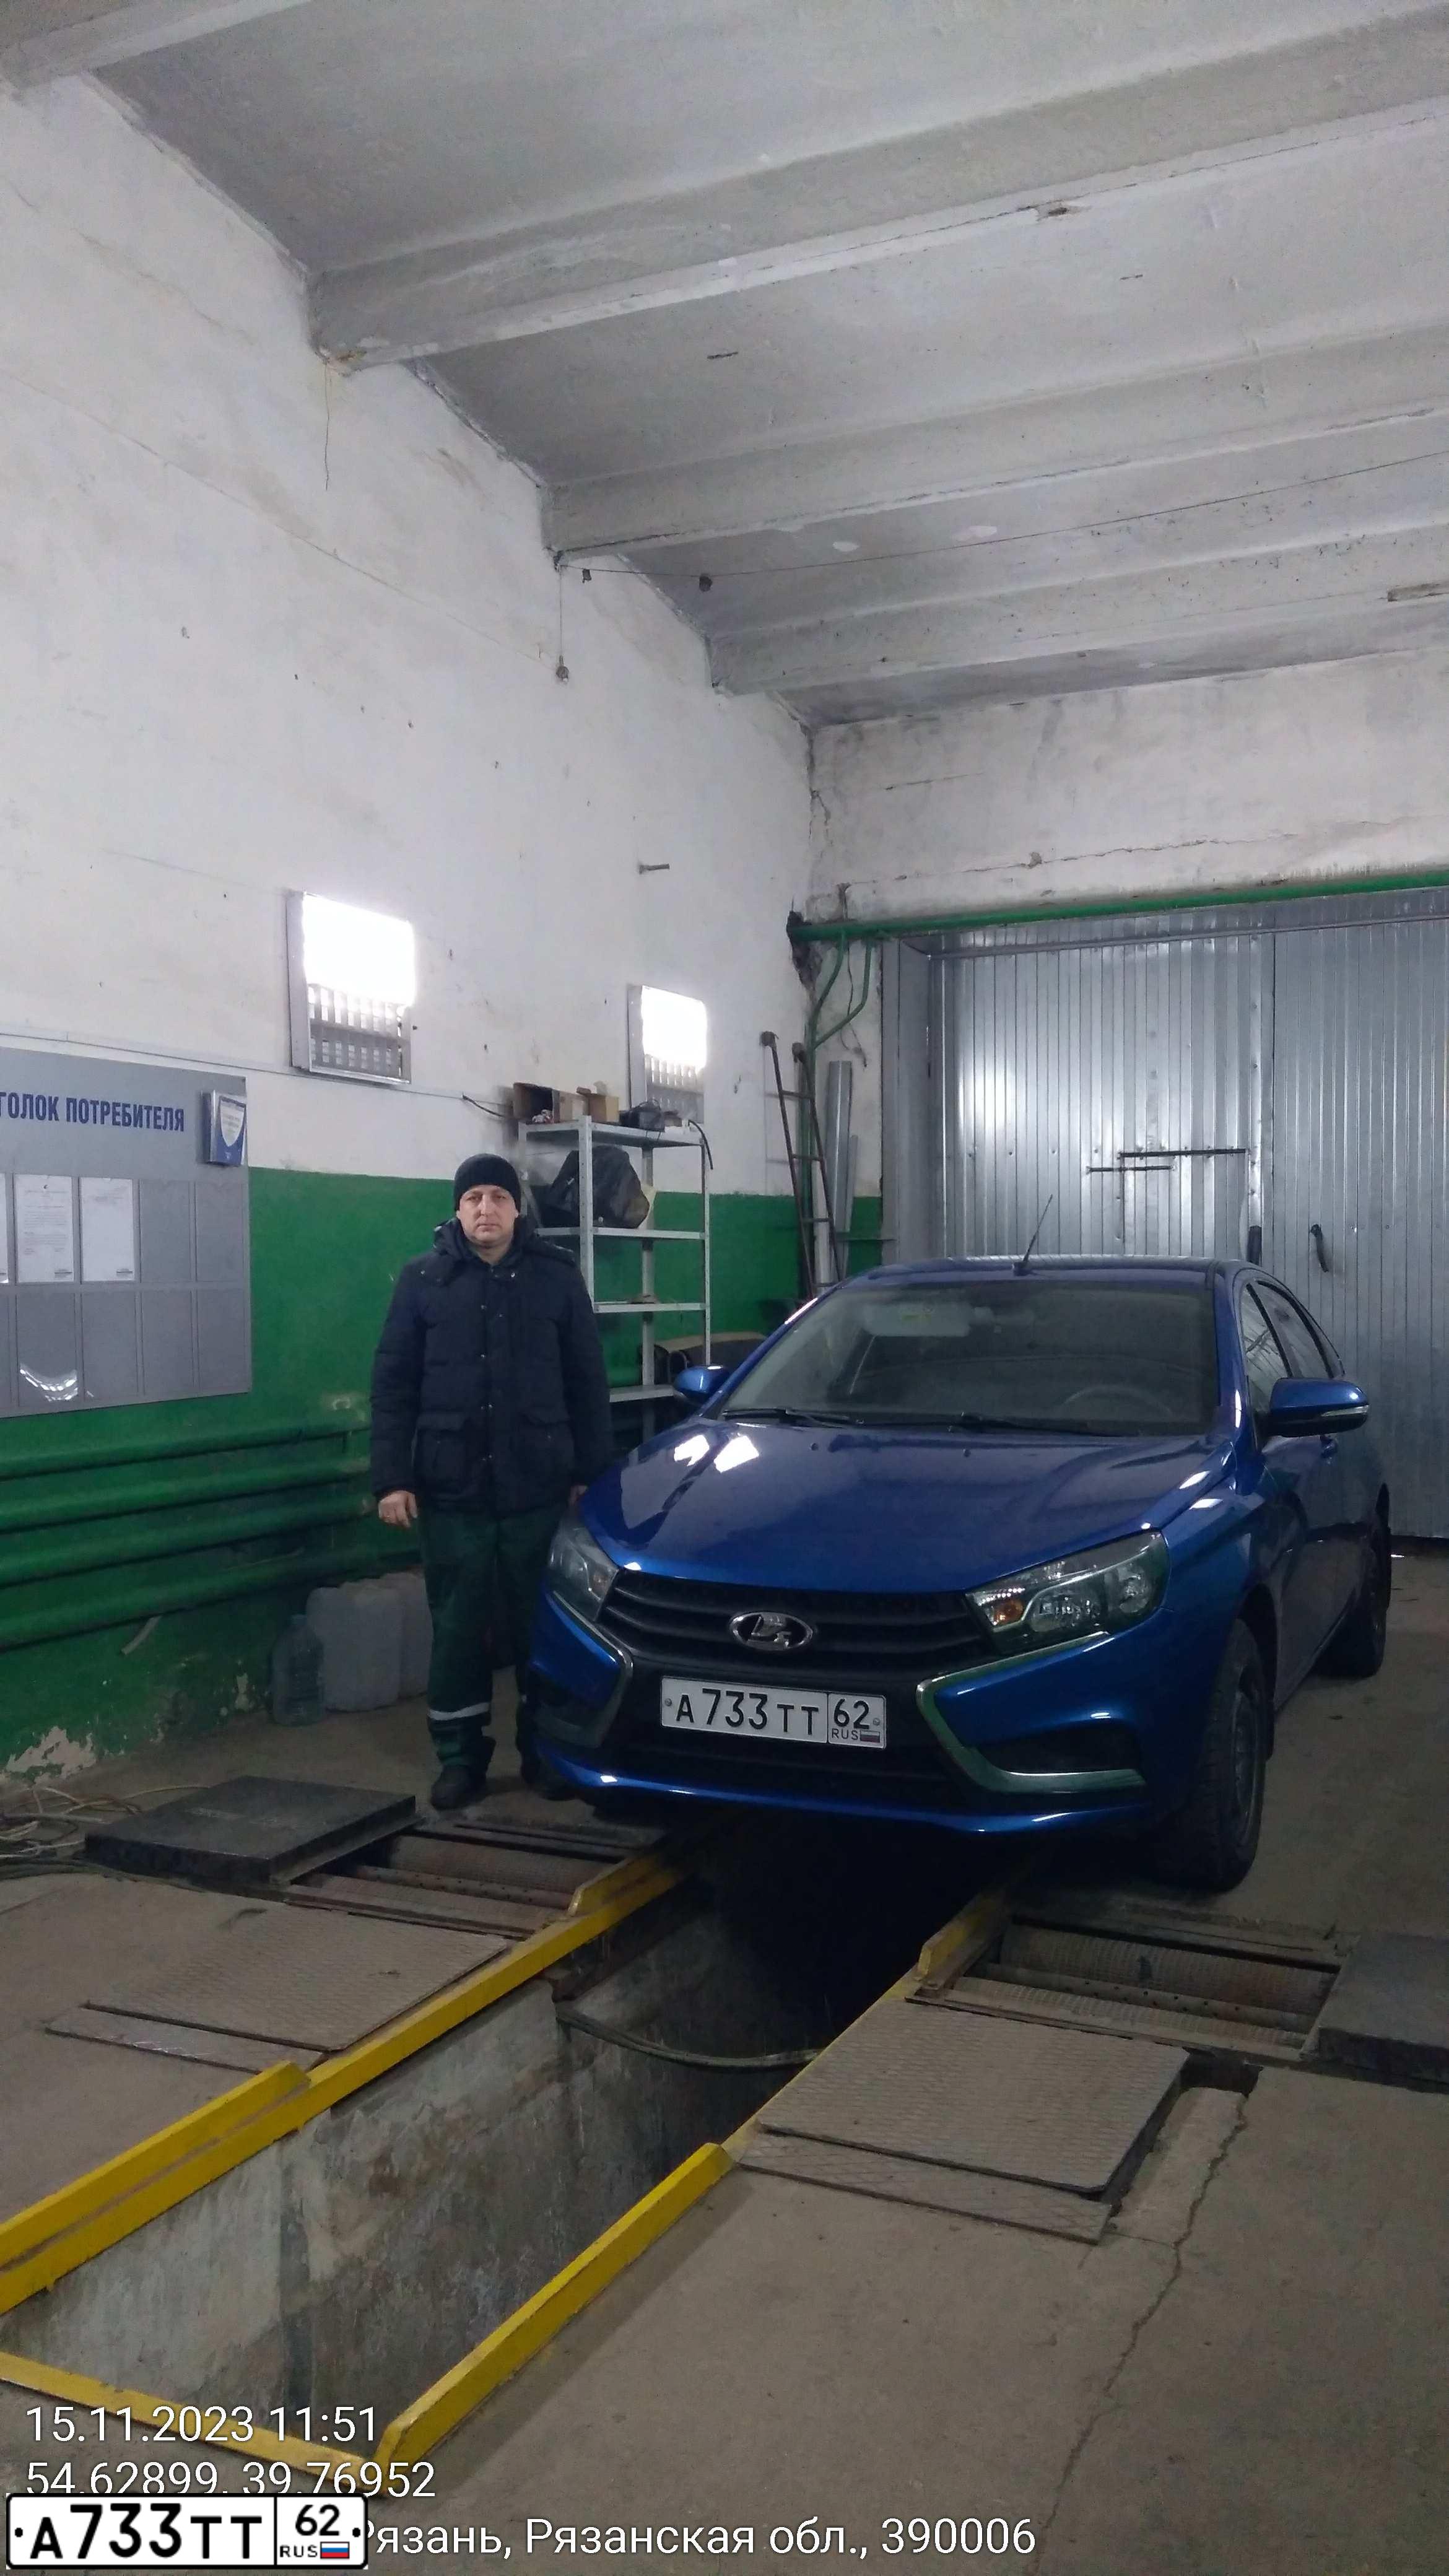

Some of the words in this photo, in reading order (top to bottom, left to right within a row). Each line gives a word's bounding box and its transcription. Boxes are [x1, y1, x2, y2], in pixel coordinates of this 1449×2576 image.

[66, 1097, 184, 1132] ПОТРЕБИТЕЛЯ
[833, 1699, 869, 1730] 62
[832, 1728, 858, 1740] RUS
